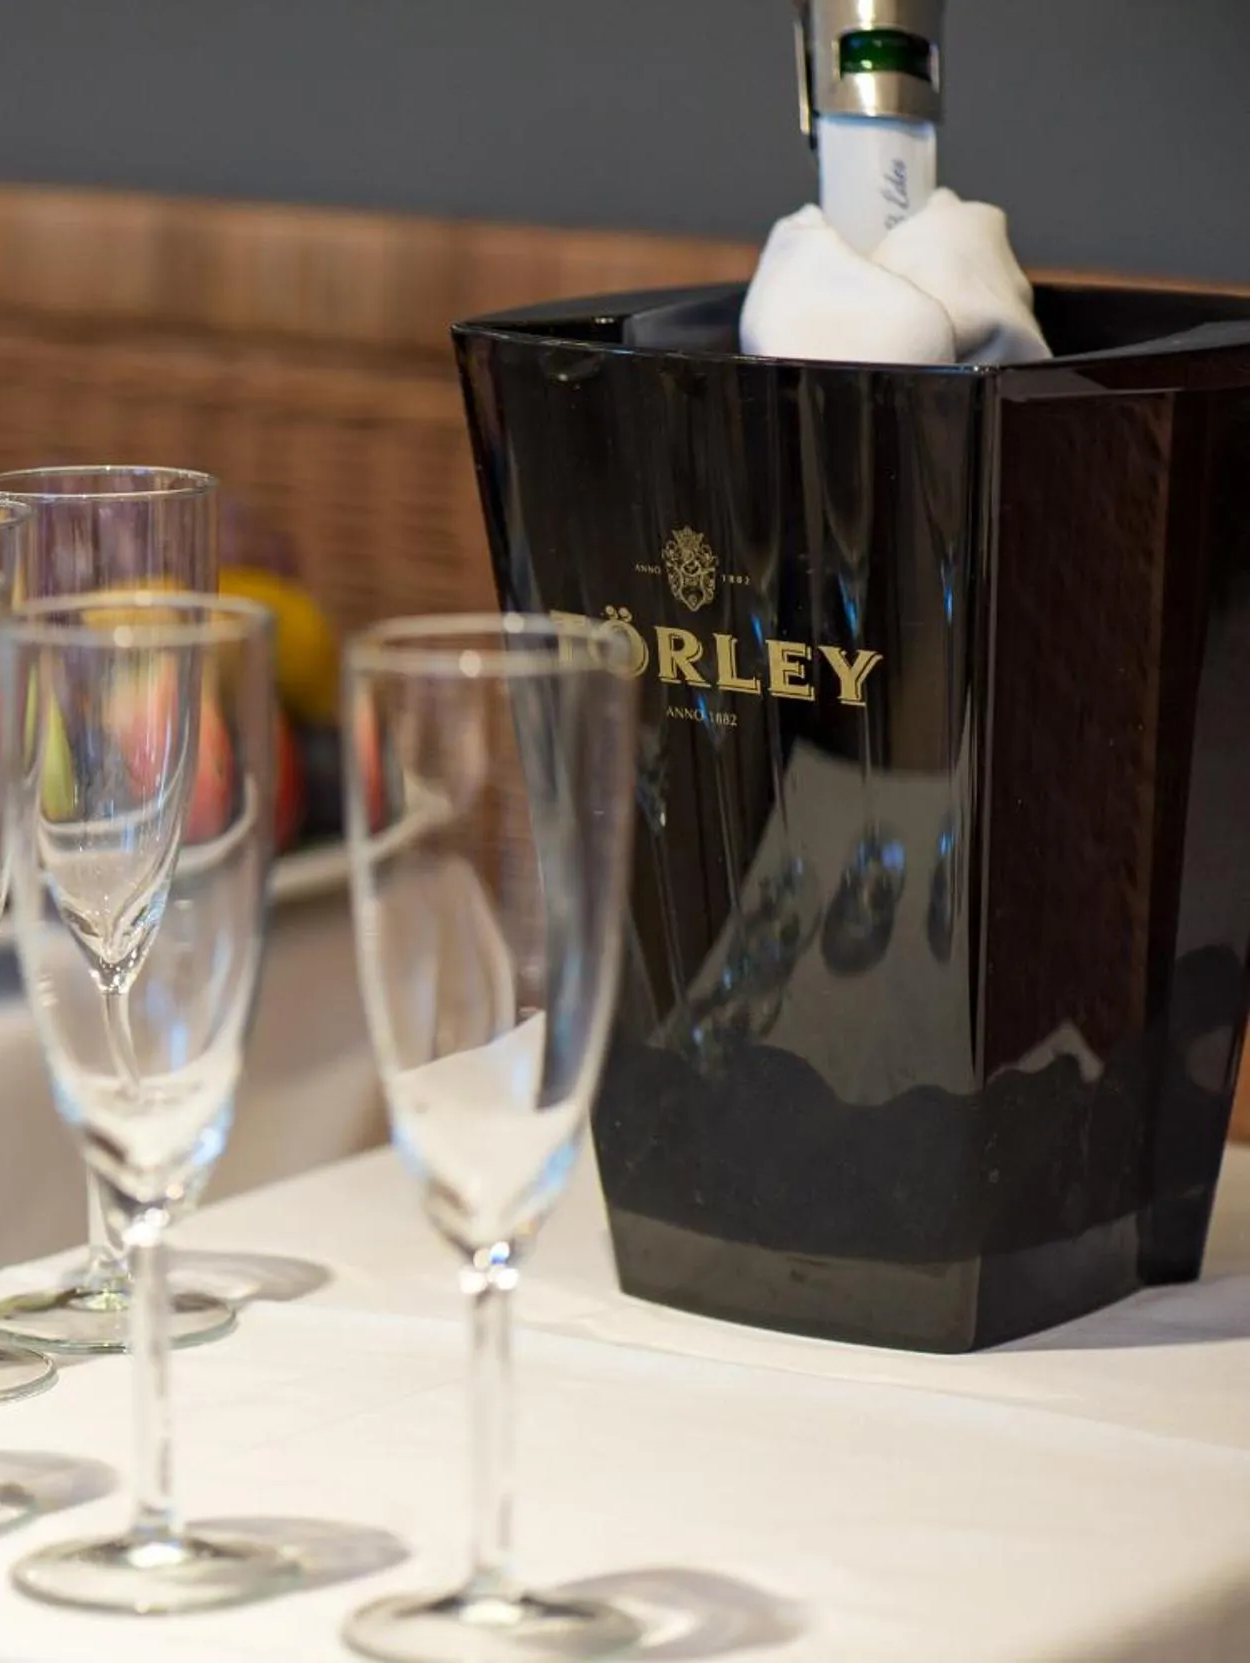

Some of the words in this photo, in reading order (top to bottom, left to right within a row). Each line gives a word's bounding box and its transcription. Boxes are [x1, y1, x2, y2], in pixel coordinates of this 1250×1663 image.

[634, 563, 662, 575] ANNO
[720, 573, 751, 586] 1882
[666, 705, 705, 722] ANNO
[709, 711, 738, 727] 1882
